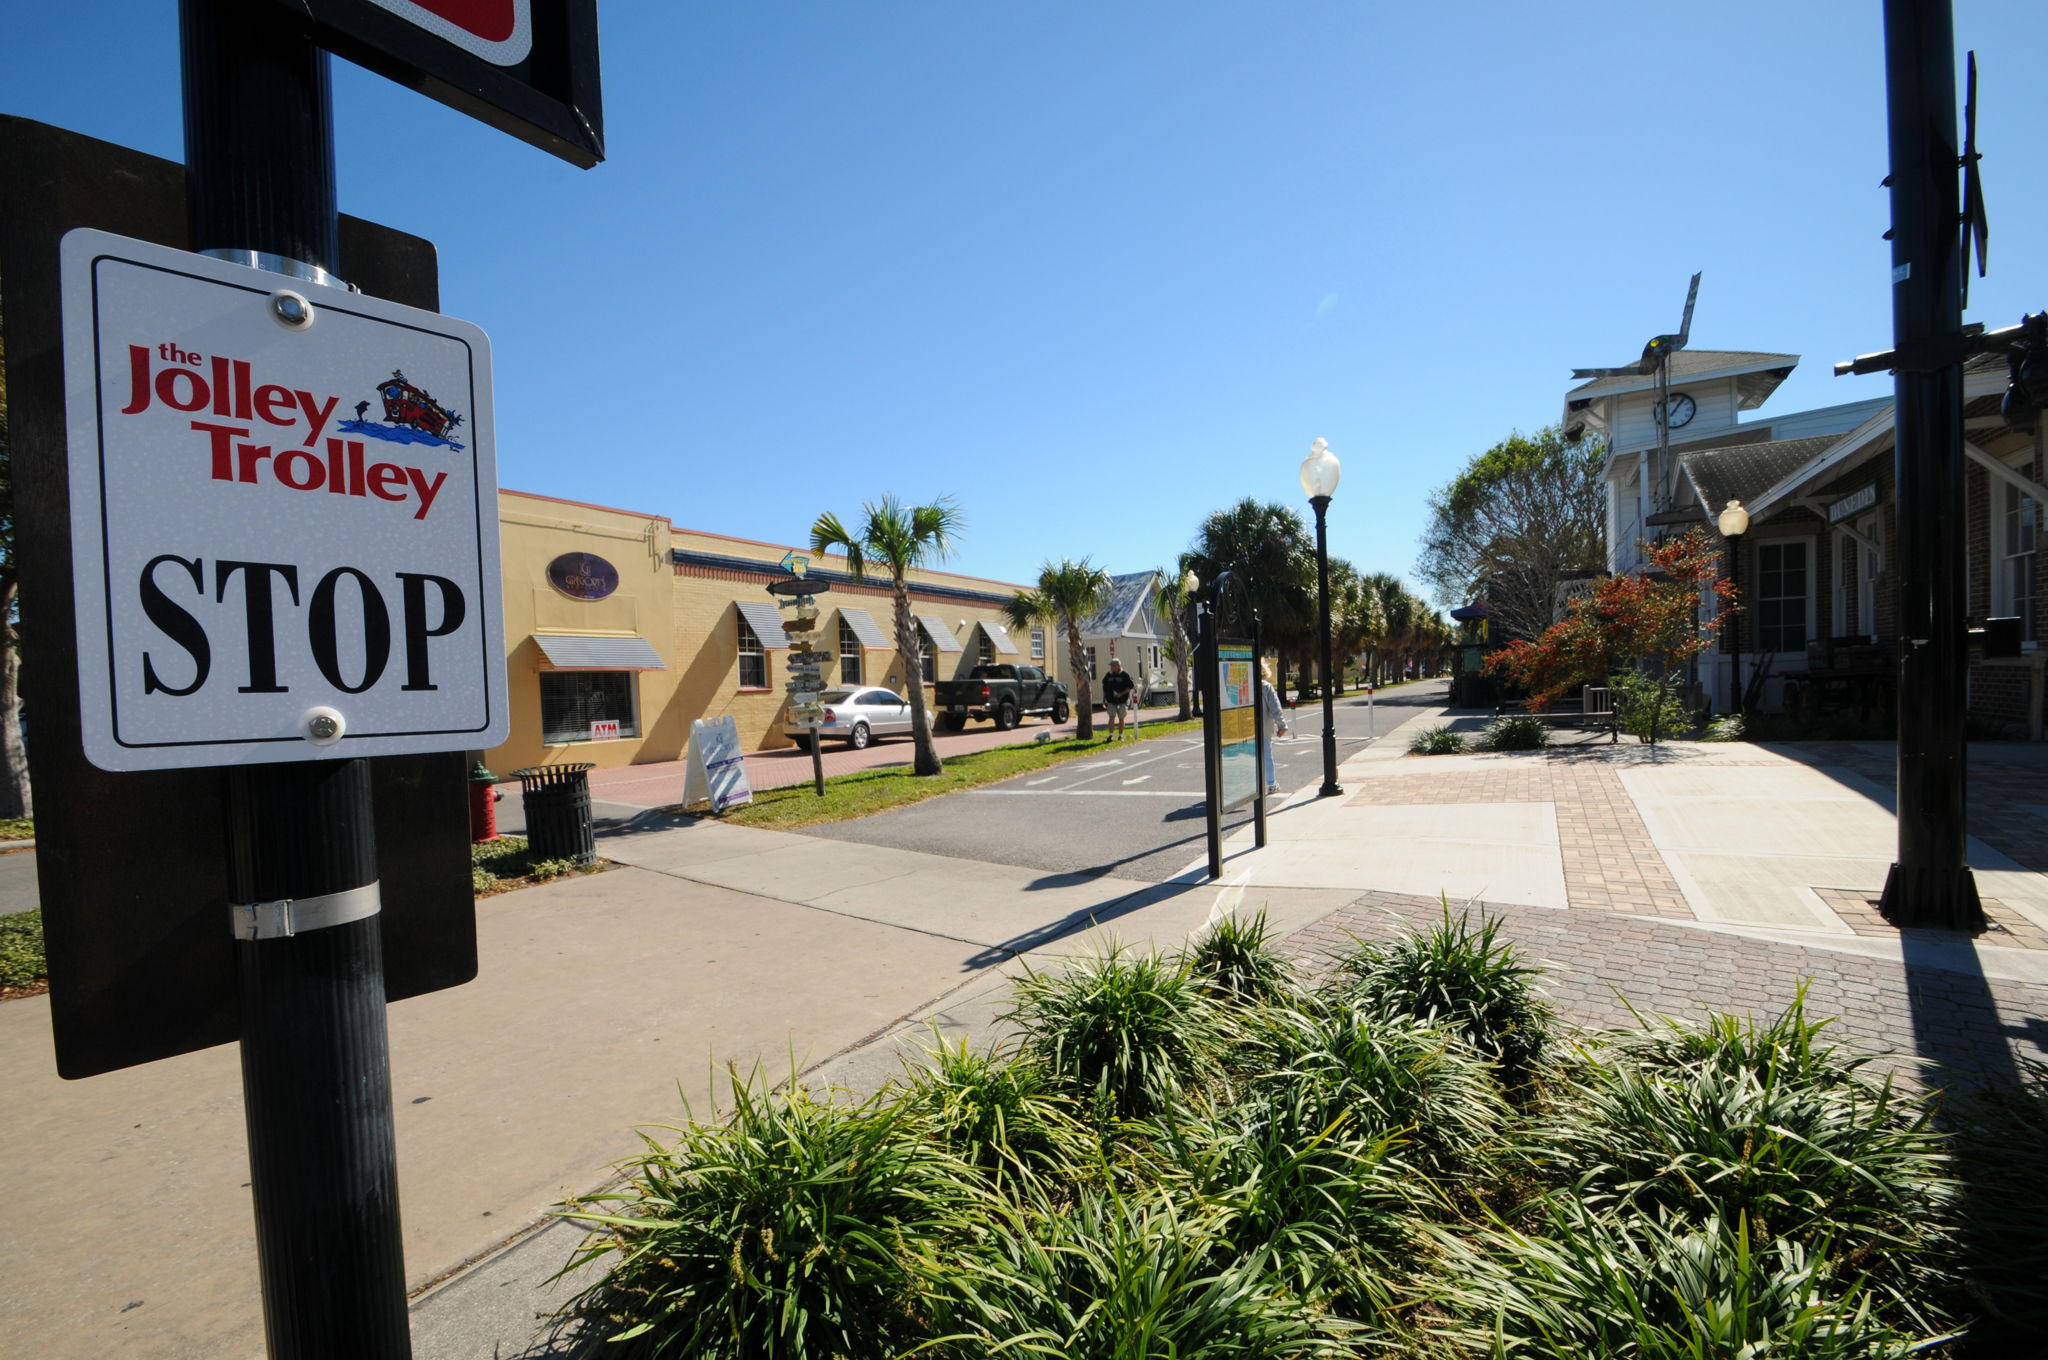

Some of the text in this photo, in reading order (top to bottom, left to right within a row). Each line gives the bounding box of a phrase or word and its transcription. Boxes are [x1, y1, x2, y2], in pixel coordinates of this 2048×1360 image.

[121, 344, 340, 447] Jolley
[158, 342, 203, 367] the
[190, 421, 448, 520] Trolley
[139, 554, 466, 697] STOP
[594, 723, 618, 736] ATM
